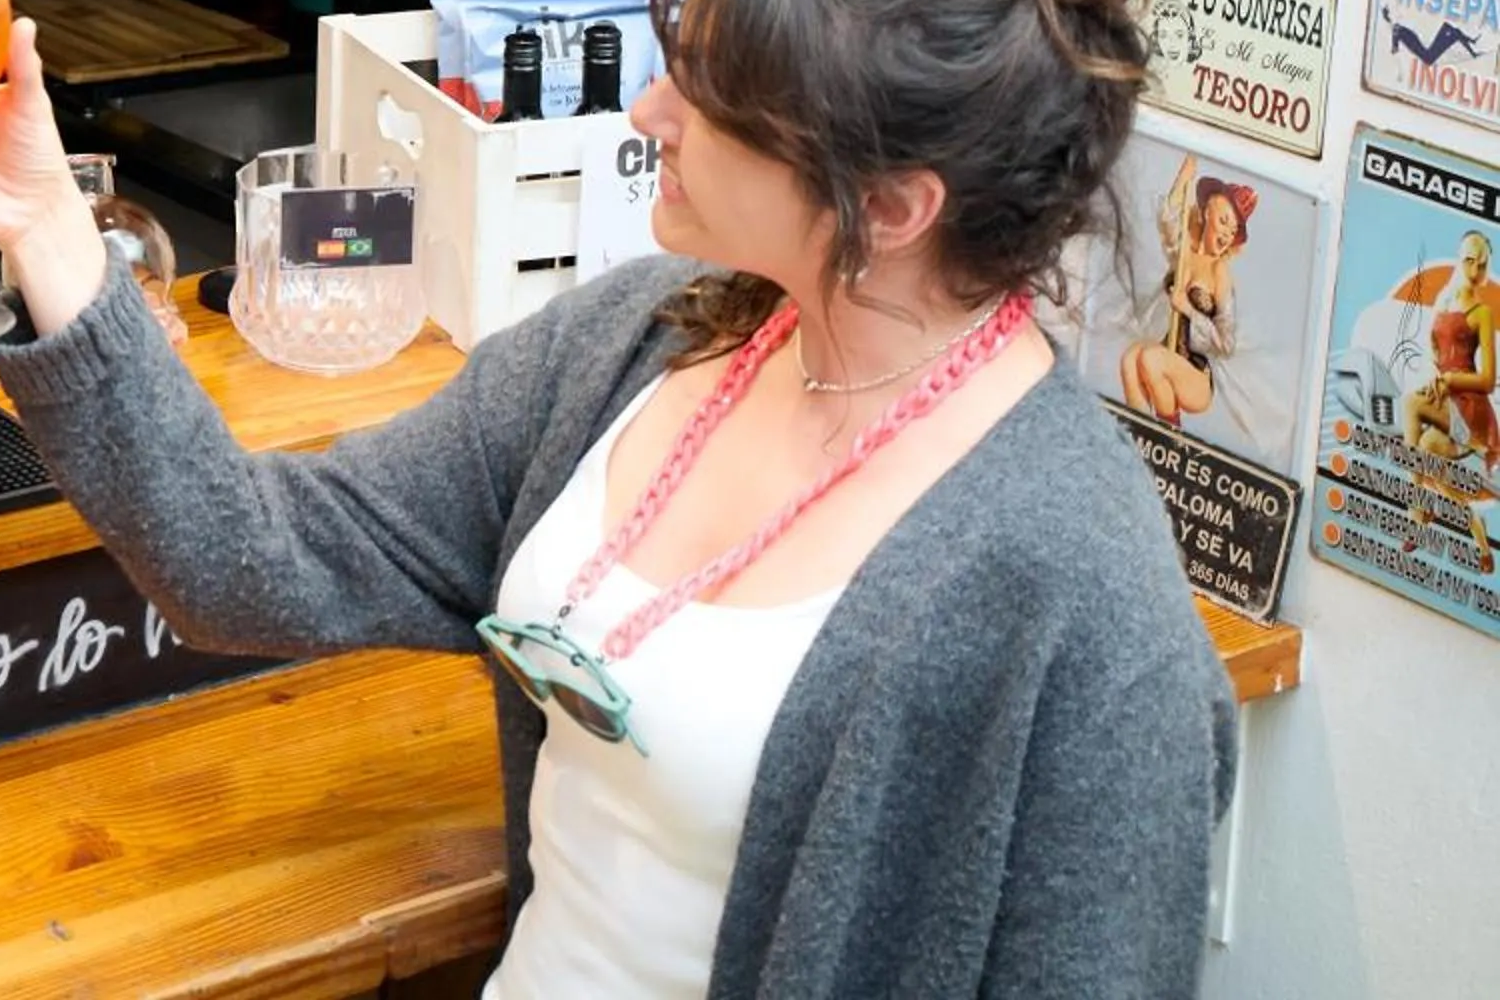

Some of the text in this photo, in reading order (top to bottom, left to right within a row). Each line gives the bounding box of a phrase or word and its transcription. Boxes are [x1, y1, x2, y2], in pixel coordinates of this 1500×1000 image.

[1225, 40, 1255, 62] Mi
[1261, 54, 1314, 83] Mayor
[1409, 58, 1500, 113] INOLVI
[1193, 64, 1311, 134] TESORO
[1365, 152, 1486, 213] GARAGE
[1138, 436, 1279, 517] MOR ES COMO
[1155, 476, 1234, 532] PALOMA
[1179, 519, 1253, 573] Y SE VA
[1188, 559, 1214, 583] 365
[1471, 582, 1500, 620] TOOL
[39, 596, 123, 693] lo
